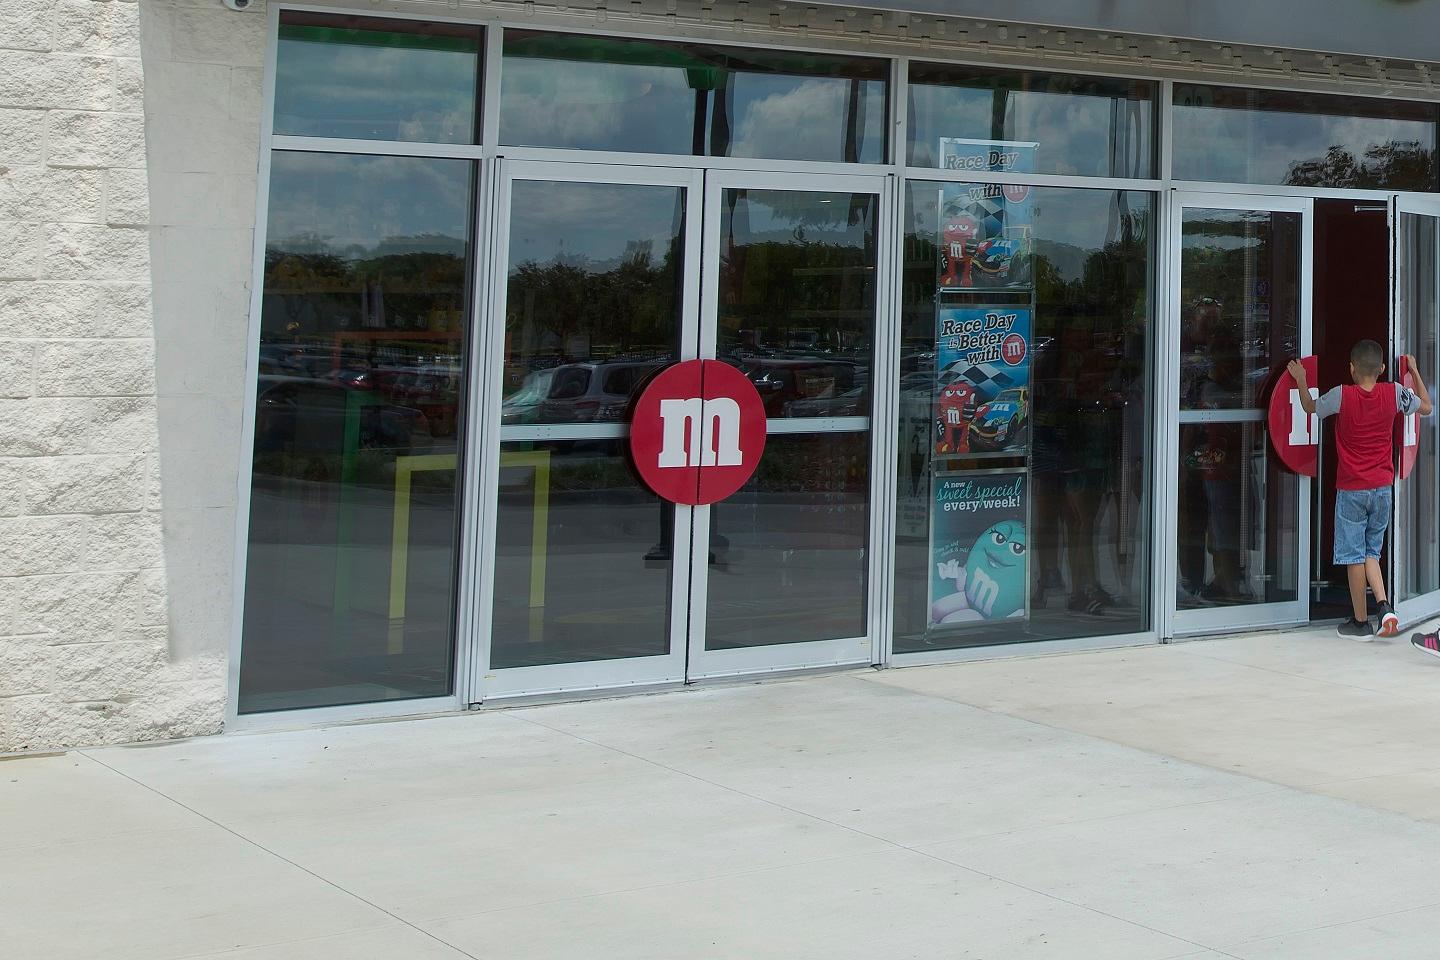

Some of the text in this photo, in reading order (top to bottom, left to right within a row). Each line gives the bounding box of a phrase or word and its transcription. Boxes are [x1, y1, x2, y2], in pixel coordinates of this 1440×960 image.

[944, 150, 1018, 169] Race Day
[941, 313, 1016, 337] Race Day
[949, 331, 1005, 351] is Better
[967, 345, 1000, 365] with
[658, 397, 743, 468] m
[936, 476, 1022, 508] sweet special
[943, 495, 1020, 512] every week!
